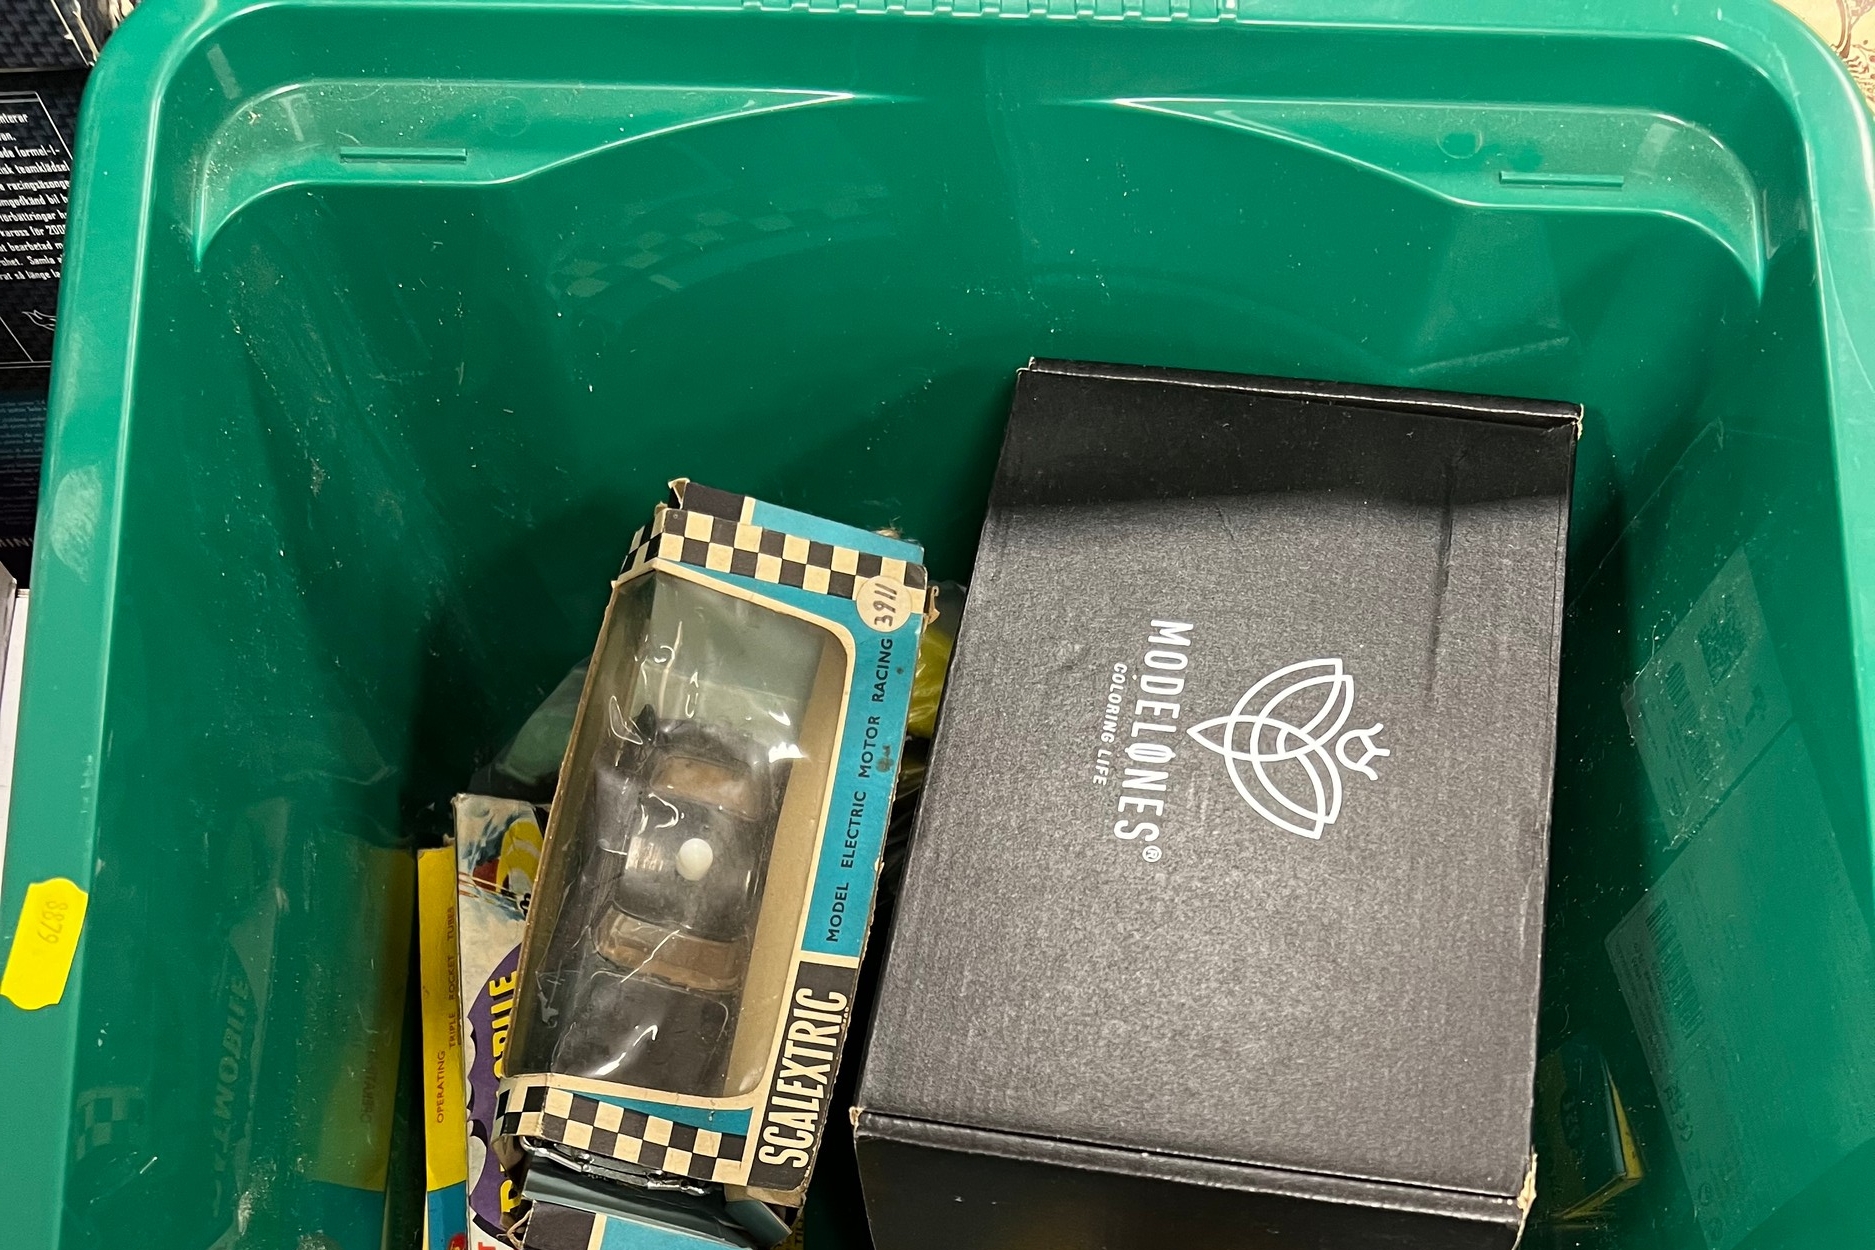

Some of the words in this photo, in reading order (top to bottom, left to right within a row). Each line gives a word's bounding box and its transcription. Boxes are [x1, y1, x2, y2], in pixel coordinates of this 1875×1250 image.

[1100, 662, 1128, 743] COLORING
[826, 881, 849, 943] MODEL
[840, 790, 867, 869] ELECTRIC
[858, 715, 881, 779] MOTOR
[871, 638, 893, 703] RACING
[1093, 748, 1111, 787] LIFE
[436, 1051, 447, 1124] OPERATING
[758, 986, 848, 1168] SCALEXTRIC
